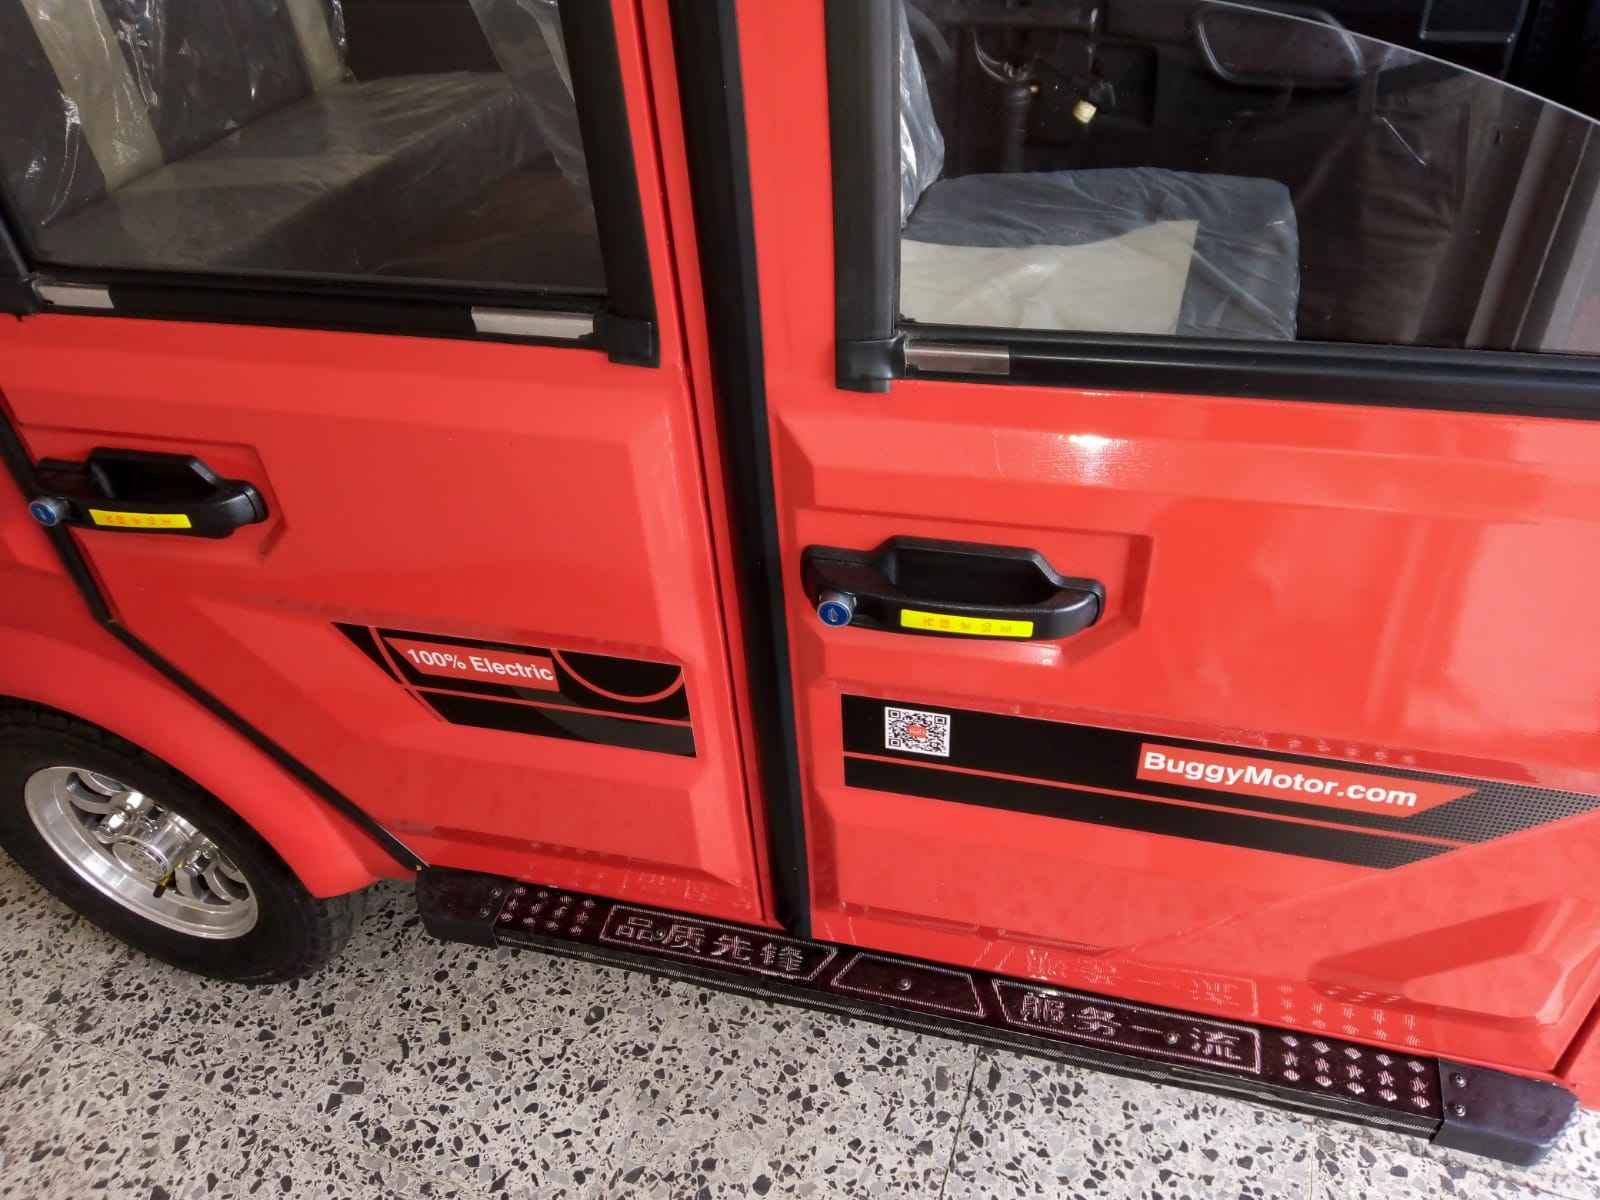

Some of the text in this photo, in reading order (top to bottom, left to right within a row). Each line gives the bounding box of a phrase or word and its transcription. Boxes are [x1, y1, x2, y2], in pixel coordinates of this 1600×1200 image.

[407, 649, 554, 681] 100% Electric
[1143, 751, 1417, 807] BuggyMotor.com
[615, 916, 804, 972] 品质先锋
[1020, 992, 1241, 1061] 服务一流
